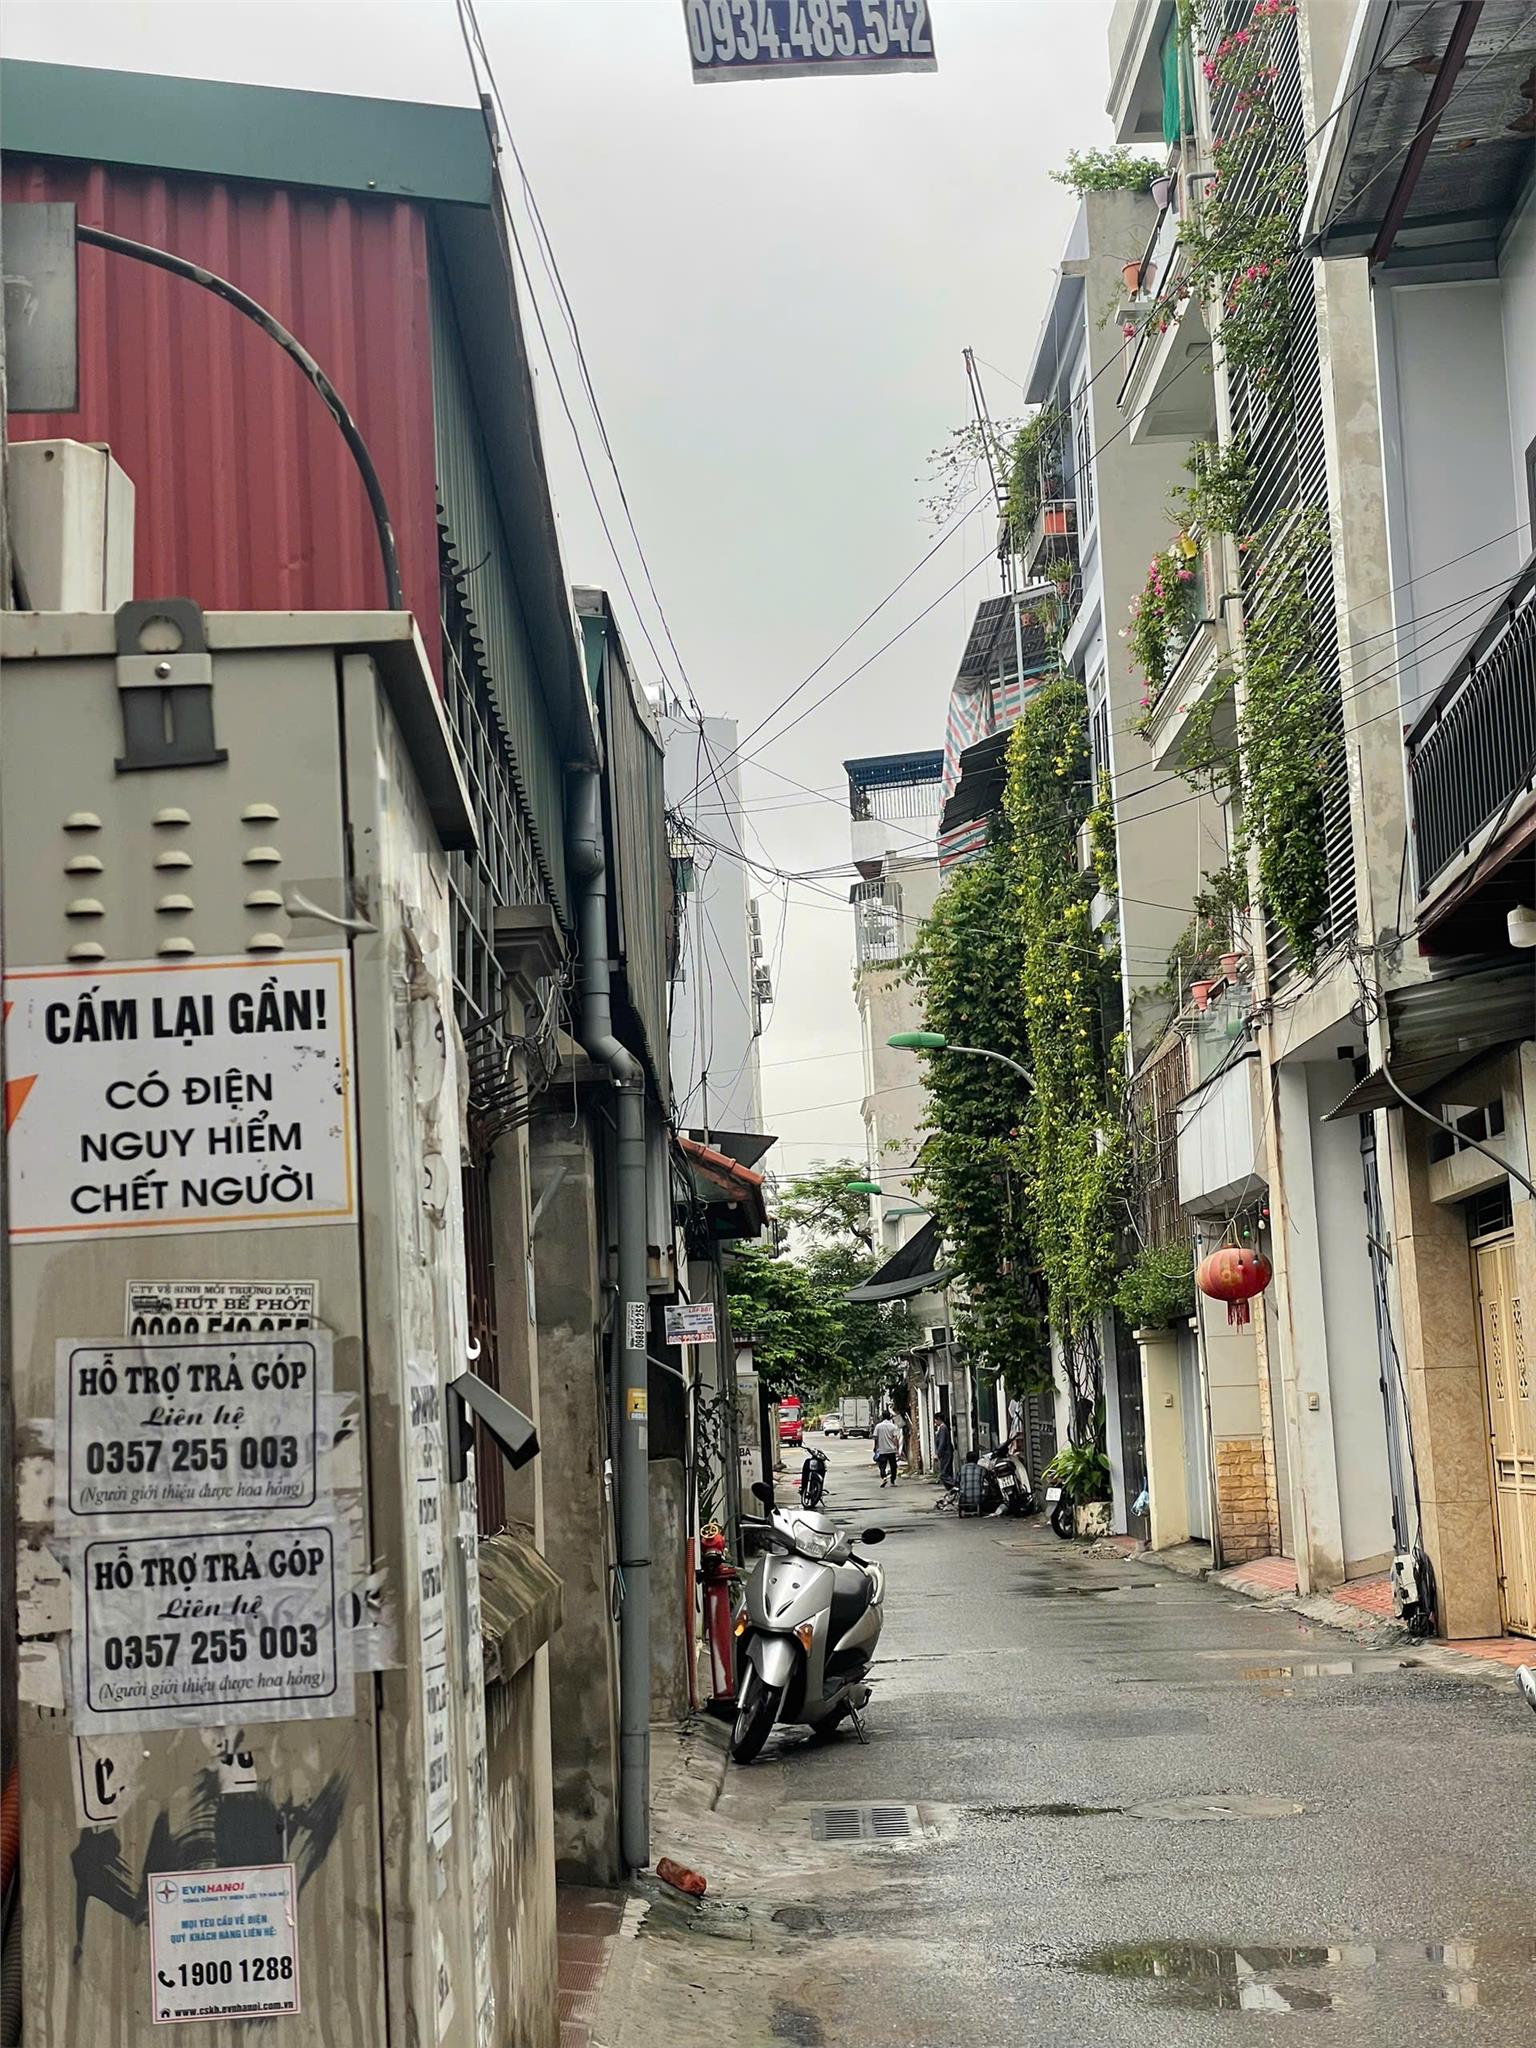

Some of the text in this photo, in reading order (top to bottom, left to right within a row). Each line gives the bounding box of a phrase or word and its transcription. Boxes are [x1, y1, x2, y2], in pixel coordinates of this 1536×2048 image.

[687, 0, 932, 63] 0934.485.542
[45, 976, 327, 1047] CẤM LẠI GẦN!
[105, 1068, 273, 1110] CÓ ĐIỆN
[80, 1109, 301, 1163] NGUY HIỂM
[70, 1164, 313, 1214] CHẾT NGƯỜI
[174, 1285, 201, 1294] SINH
[175, 1295, 310, 1311] HÚT BỂ PHỐT
[634, 1304, 645, 1317] 255
[78, 1352, 306, 1400] HỖ TRỢ TRẢ GÓP
[140, 1405, 245, 1430] Liên hệ
[86, 1435, 298, 1474] 0357 255 003
[130, 1484, 158, 1504] giới
[162, 1482, 196, 1502] thiệu
[199, 1482, 234, 1501] được
[237, 1481, 263, 1497] hoa
[94, 1540, 324, 1592] HỖ TRỢ TRẢ GÓP
[157, 1598, 222, 1621] Liên
[231, 1594, 263, 1619] hệ
[105, 1624, 318, 1671] 0357 255 003
[98, 1681, 147, 1704] (Người
[150, 1678, 179, 1699] giới
[182, 1676, 216, 1695] thiệu
[219, 1674, 254, 1693] được
[257, 1672, 283, 1688] hoa
[189, 1931, 217, 1942] KHÁCH
[178, 1956, 293, 1987] 1900 1288
[174, 2001, 294, 2017] www.cskh.evnhanoi.com.vn
